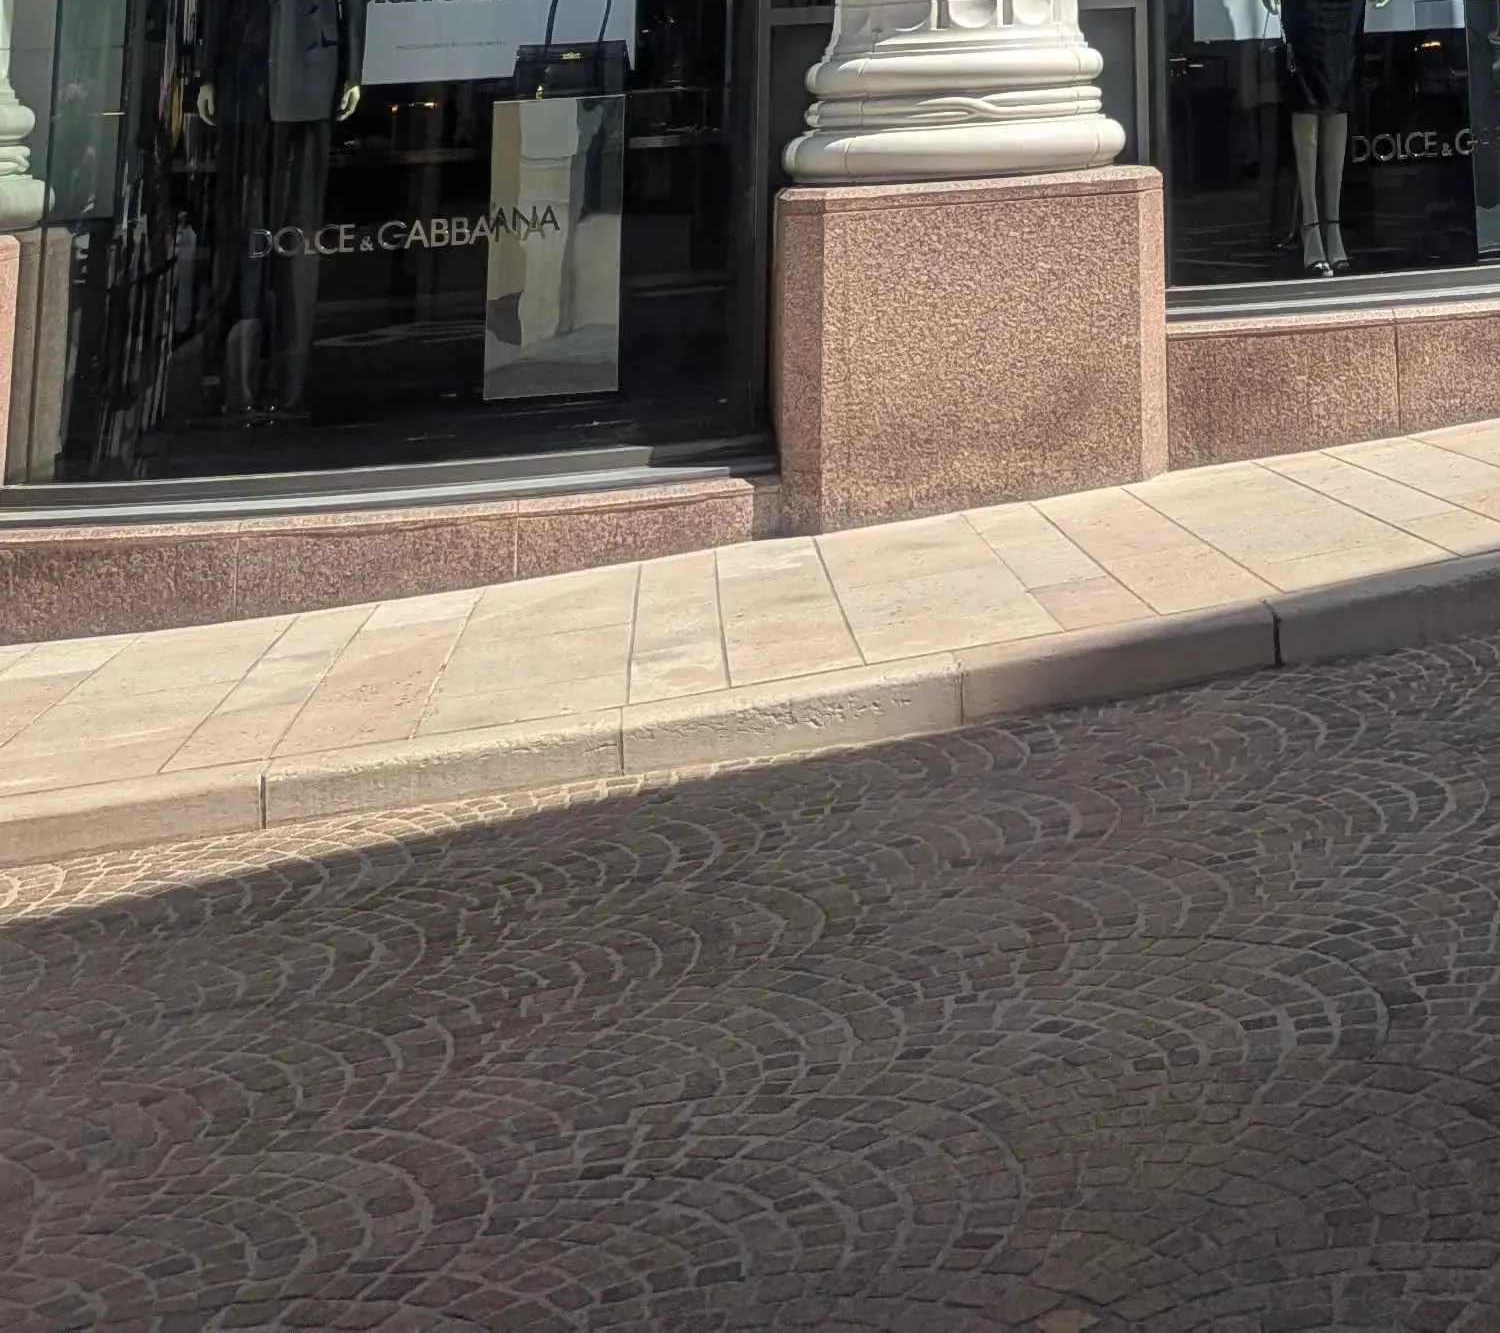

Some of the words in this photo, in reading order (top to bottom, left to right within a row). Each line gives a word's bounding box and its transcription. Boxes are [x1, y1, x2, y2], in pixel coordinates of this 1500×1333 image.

[1352, 131, 1437, 162] DOLCE
[1441, 142, 1453, 157] &
[248, 223, 356, 258] DOLCE
[360, 235, 374, 252] &
